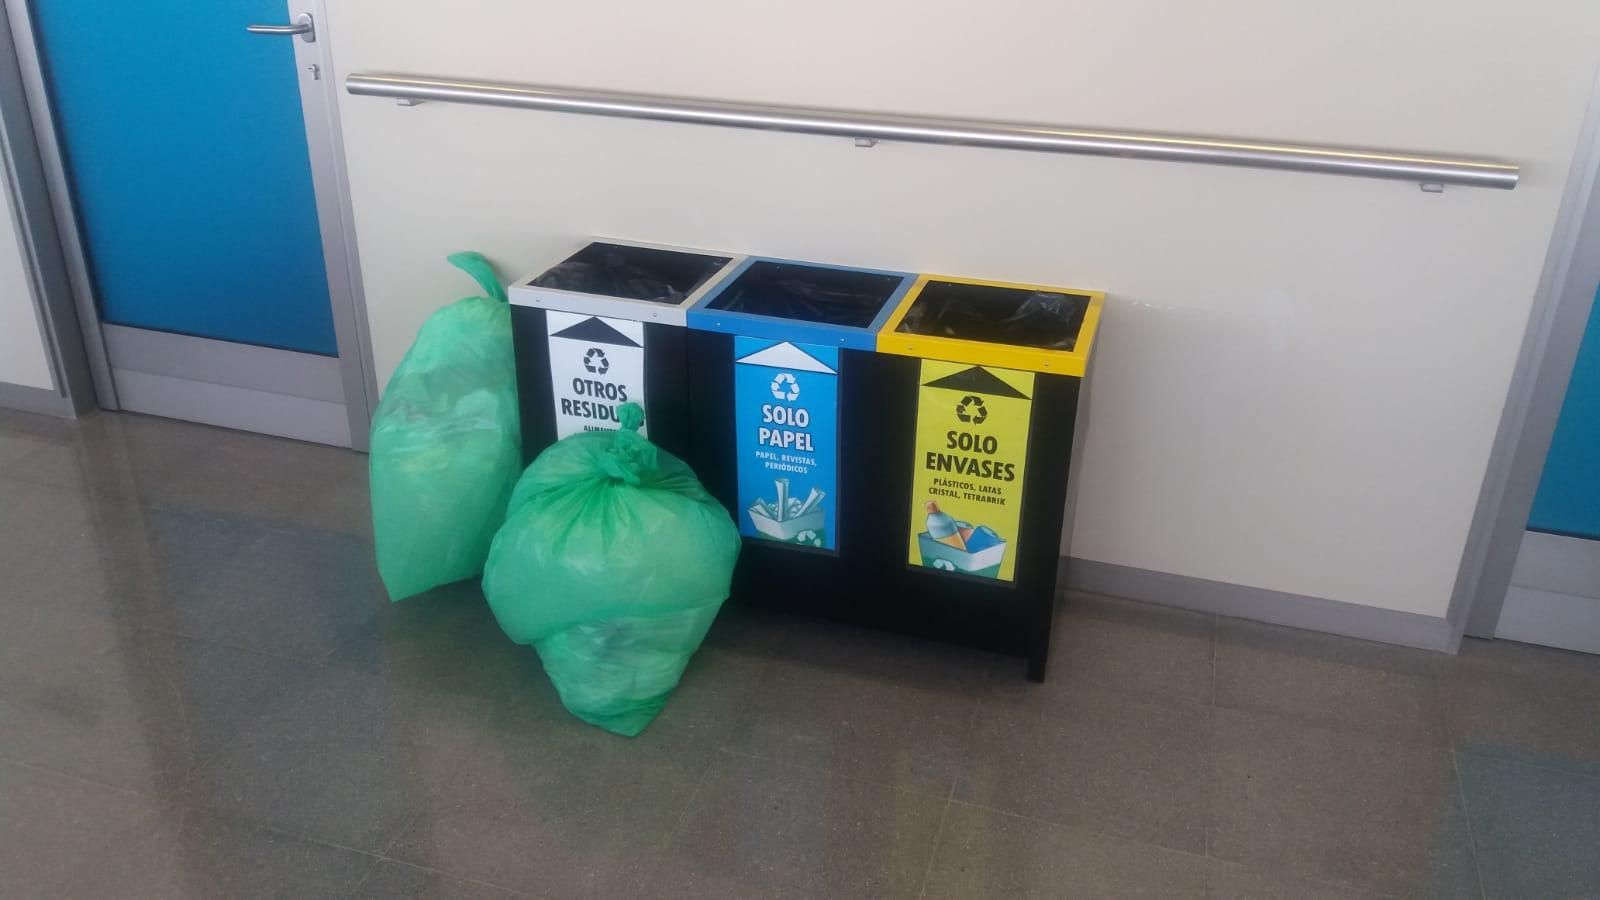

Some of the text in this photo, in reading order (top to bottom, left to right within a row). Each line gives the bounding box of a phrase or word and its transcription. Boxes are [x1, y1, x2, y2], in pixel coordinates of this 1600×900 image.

[573, 377, 627, 402] OTROS
[762, 404, 809, 428] SOLO
[759, 427, 814, 452] PAPEL
[946, 430, 998, 455] SOLO
[765, 461, 808, 474] PERIÓDICOS
[781, 454, 817, 467] REVISTAS,
[926, 451, 1015, 482] ENVASES
[928, 487, 1006, 506] CRISTAL, TETRABRIK
[933, 478, 1002, 495] PLÁSTICOS, LATAS
